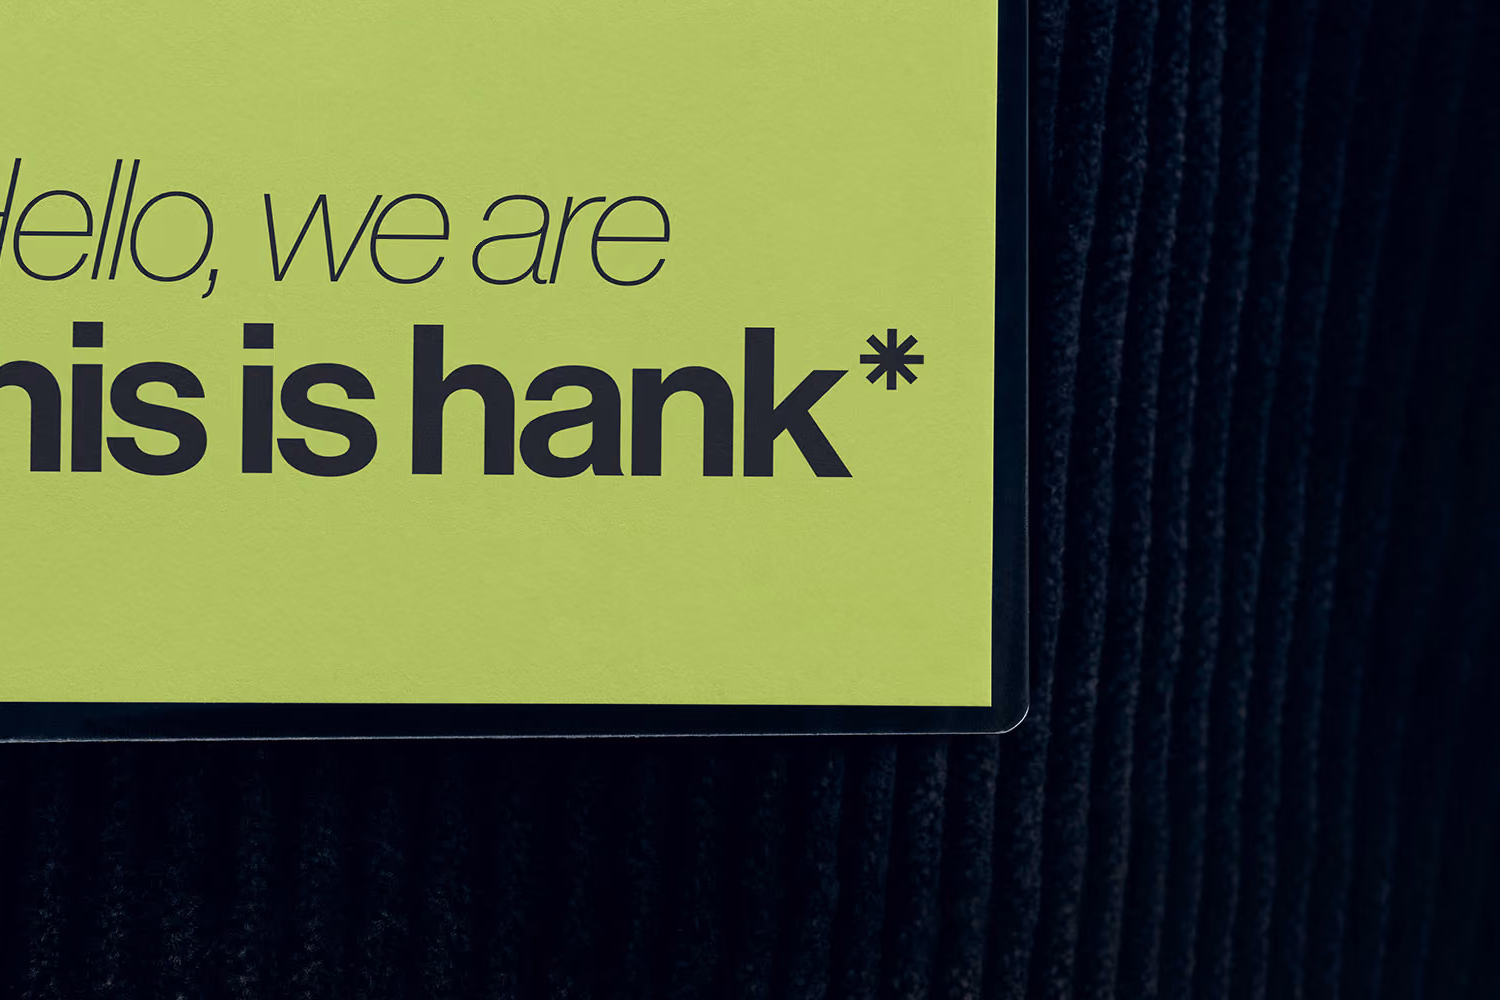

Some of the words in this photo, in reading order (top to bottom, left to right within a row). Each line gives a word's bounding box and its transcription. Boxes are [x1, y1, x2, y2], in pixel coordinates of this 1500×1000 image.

[263, 193, 450, 285] we
[471, 194, 671, 287] are
[241, 322, 378, 478] is
